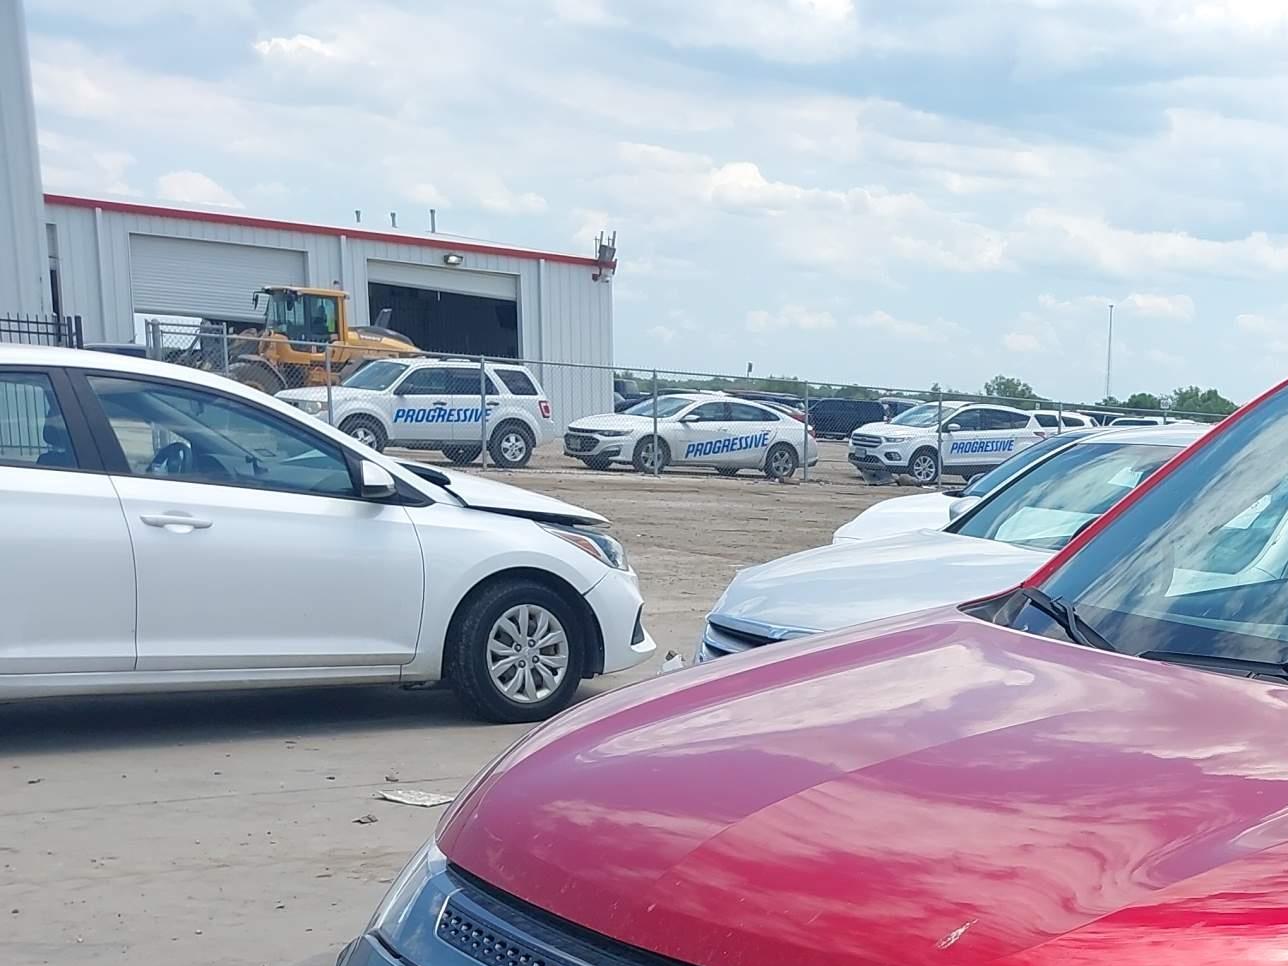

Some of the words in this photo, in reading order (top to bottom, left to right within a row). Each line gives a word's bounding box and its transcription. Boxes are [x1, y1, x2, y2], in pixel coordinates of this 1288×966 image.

[394, 408, 492, 423] PROGRESSIVE
[685, 431, 770, 459] PROGRESSIVE
[951, 438, 1015, 455] PROGRESSIVE
